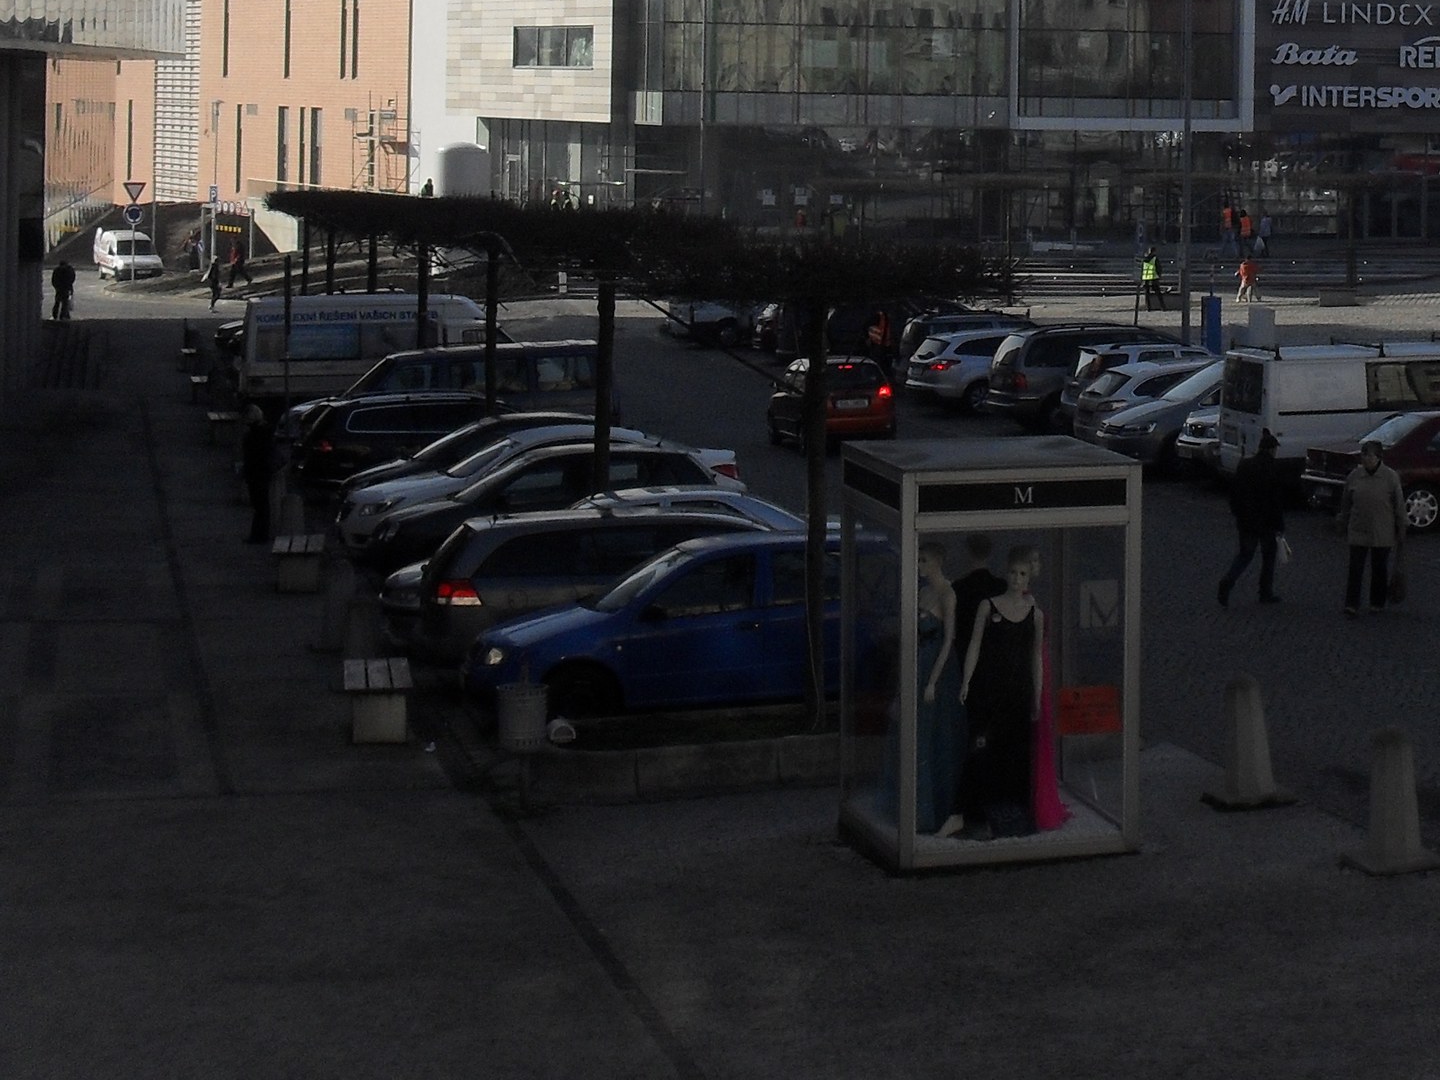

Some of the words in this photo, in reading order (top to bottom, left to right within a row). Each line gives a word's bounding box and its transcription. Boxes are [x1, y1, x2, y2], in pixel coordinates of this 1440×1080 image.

[1322, 2, 1434, 26] LINDEX
[256, 311, 317, 323] KOMPEXNÍ
[1013, 486, 1035, 505] M
